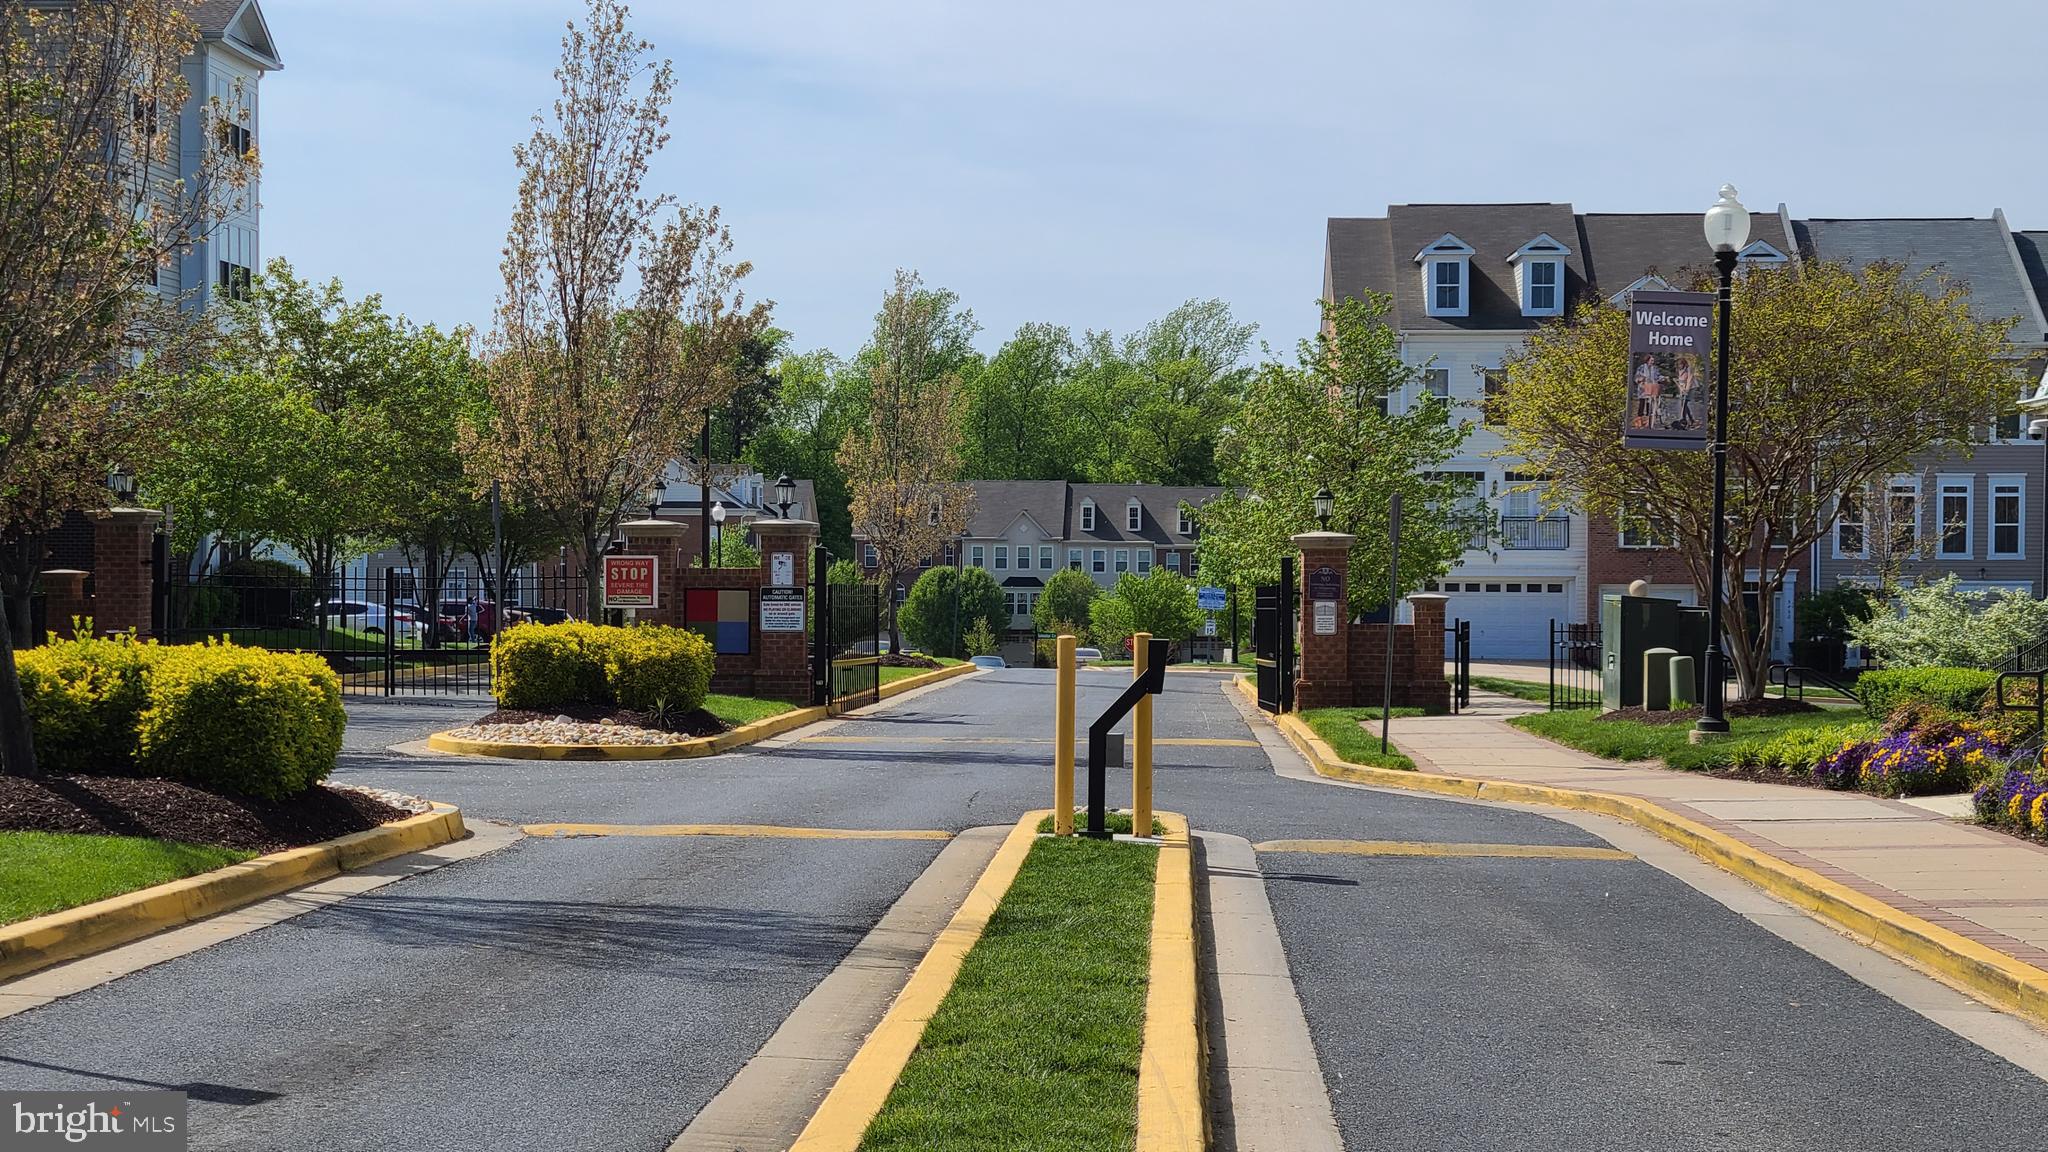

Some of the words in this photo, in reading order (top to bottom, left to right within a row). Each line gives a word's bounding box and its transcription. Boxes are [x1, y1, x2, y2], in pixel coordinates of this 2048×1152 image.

[1636, 311, 1708, 328] Welcome
[1649, 331, 1693, 346] Home
[611, 567, 648, 580] STOP
[1126, 638, 1134, 646] ST
